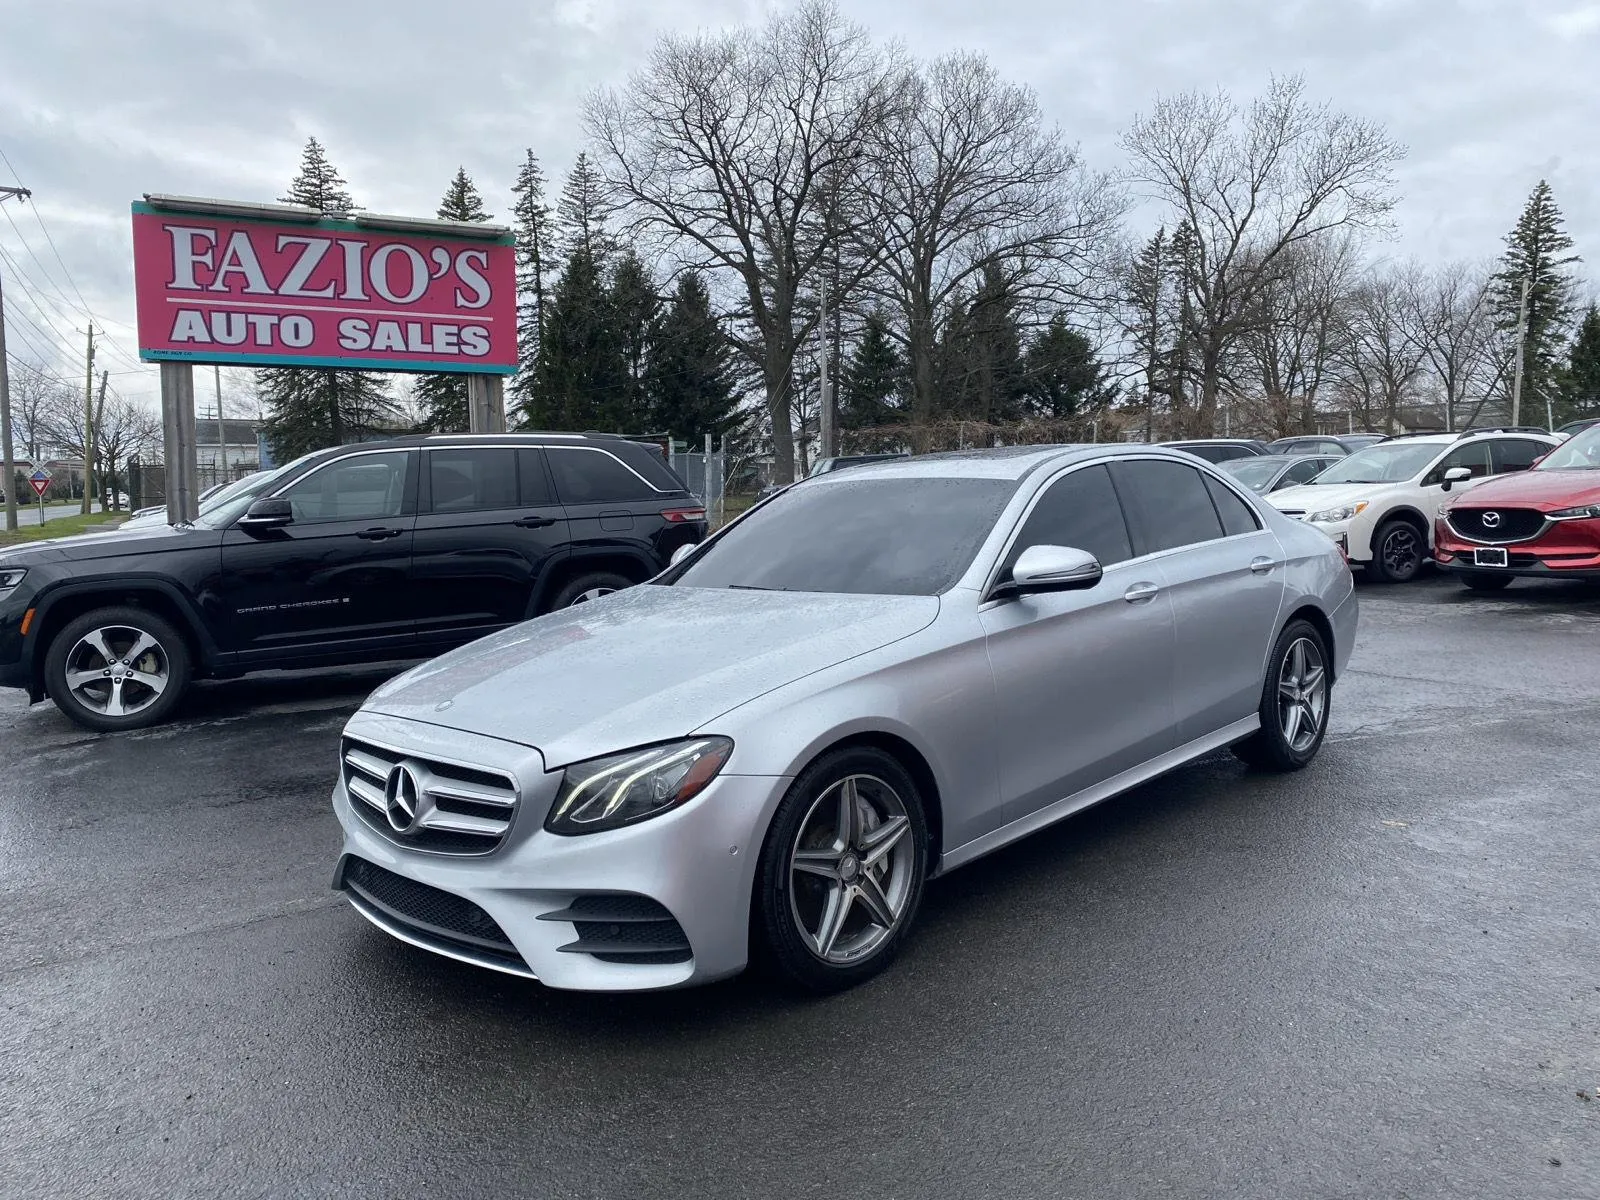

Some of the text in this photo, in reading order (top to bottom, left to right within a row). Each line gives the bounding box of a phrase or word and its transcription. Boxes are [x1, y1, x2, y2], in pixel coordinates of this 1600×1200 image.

[163, 225, 492, 309] FAZIO'S
[169, 309, 491, 356] AUTO SALES
[236, 598, 339, 614] GRAND CHEROKEE
